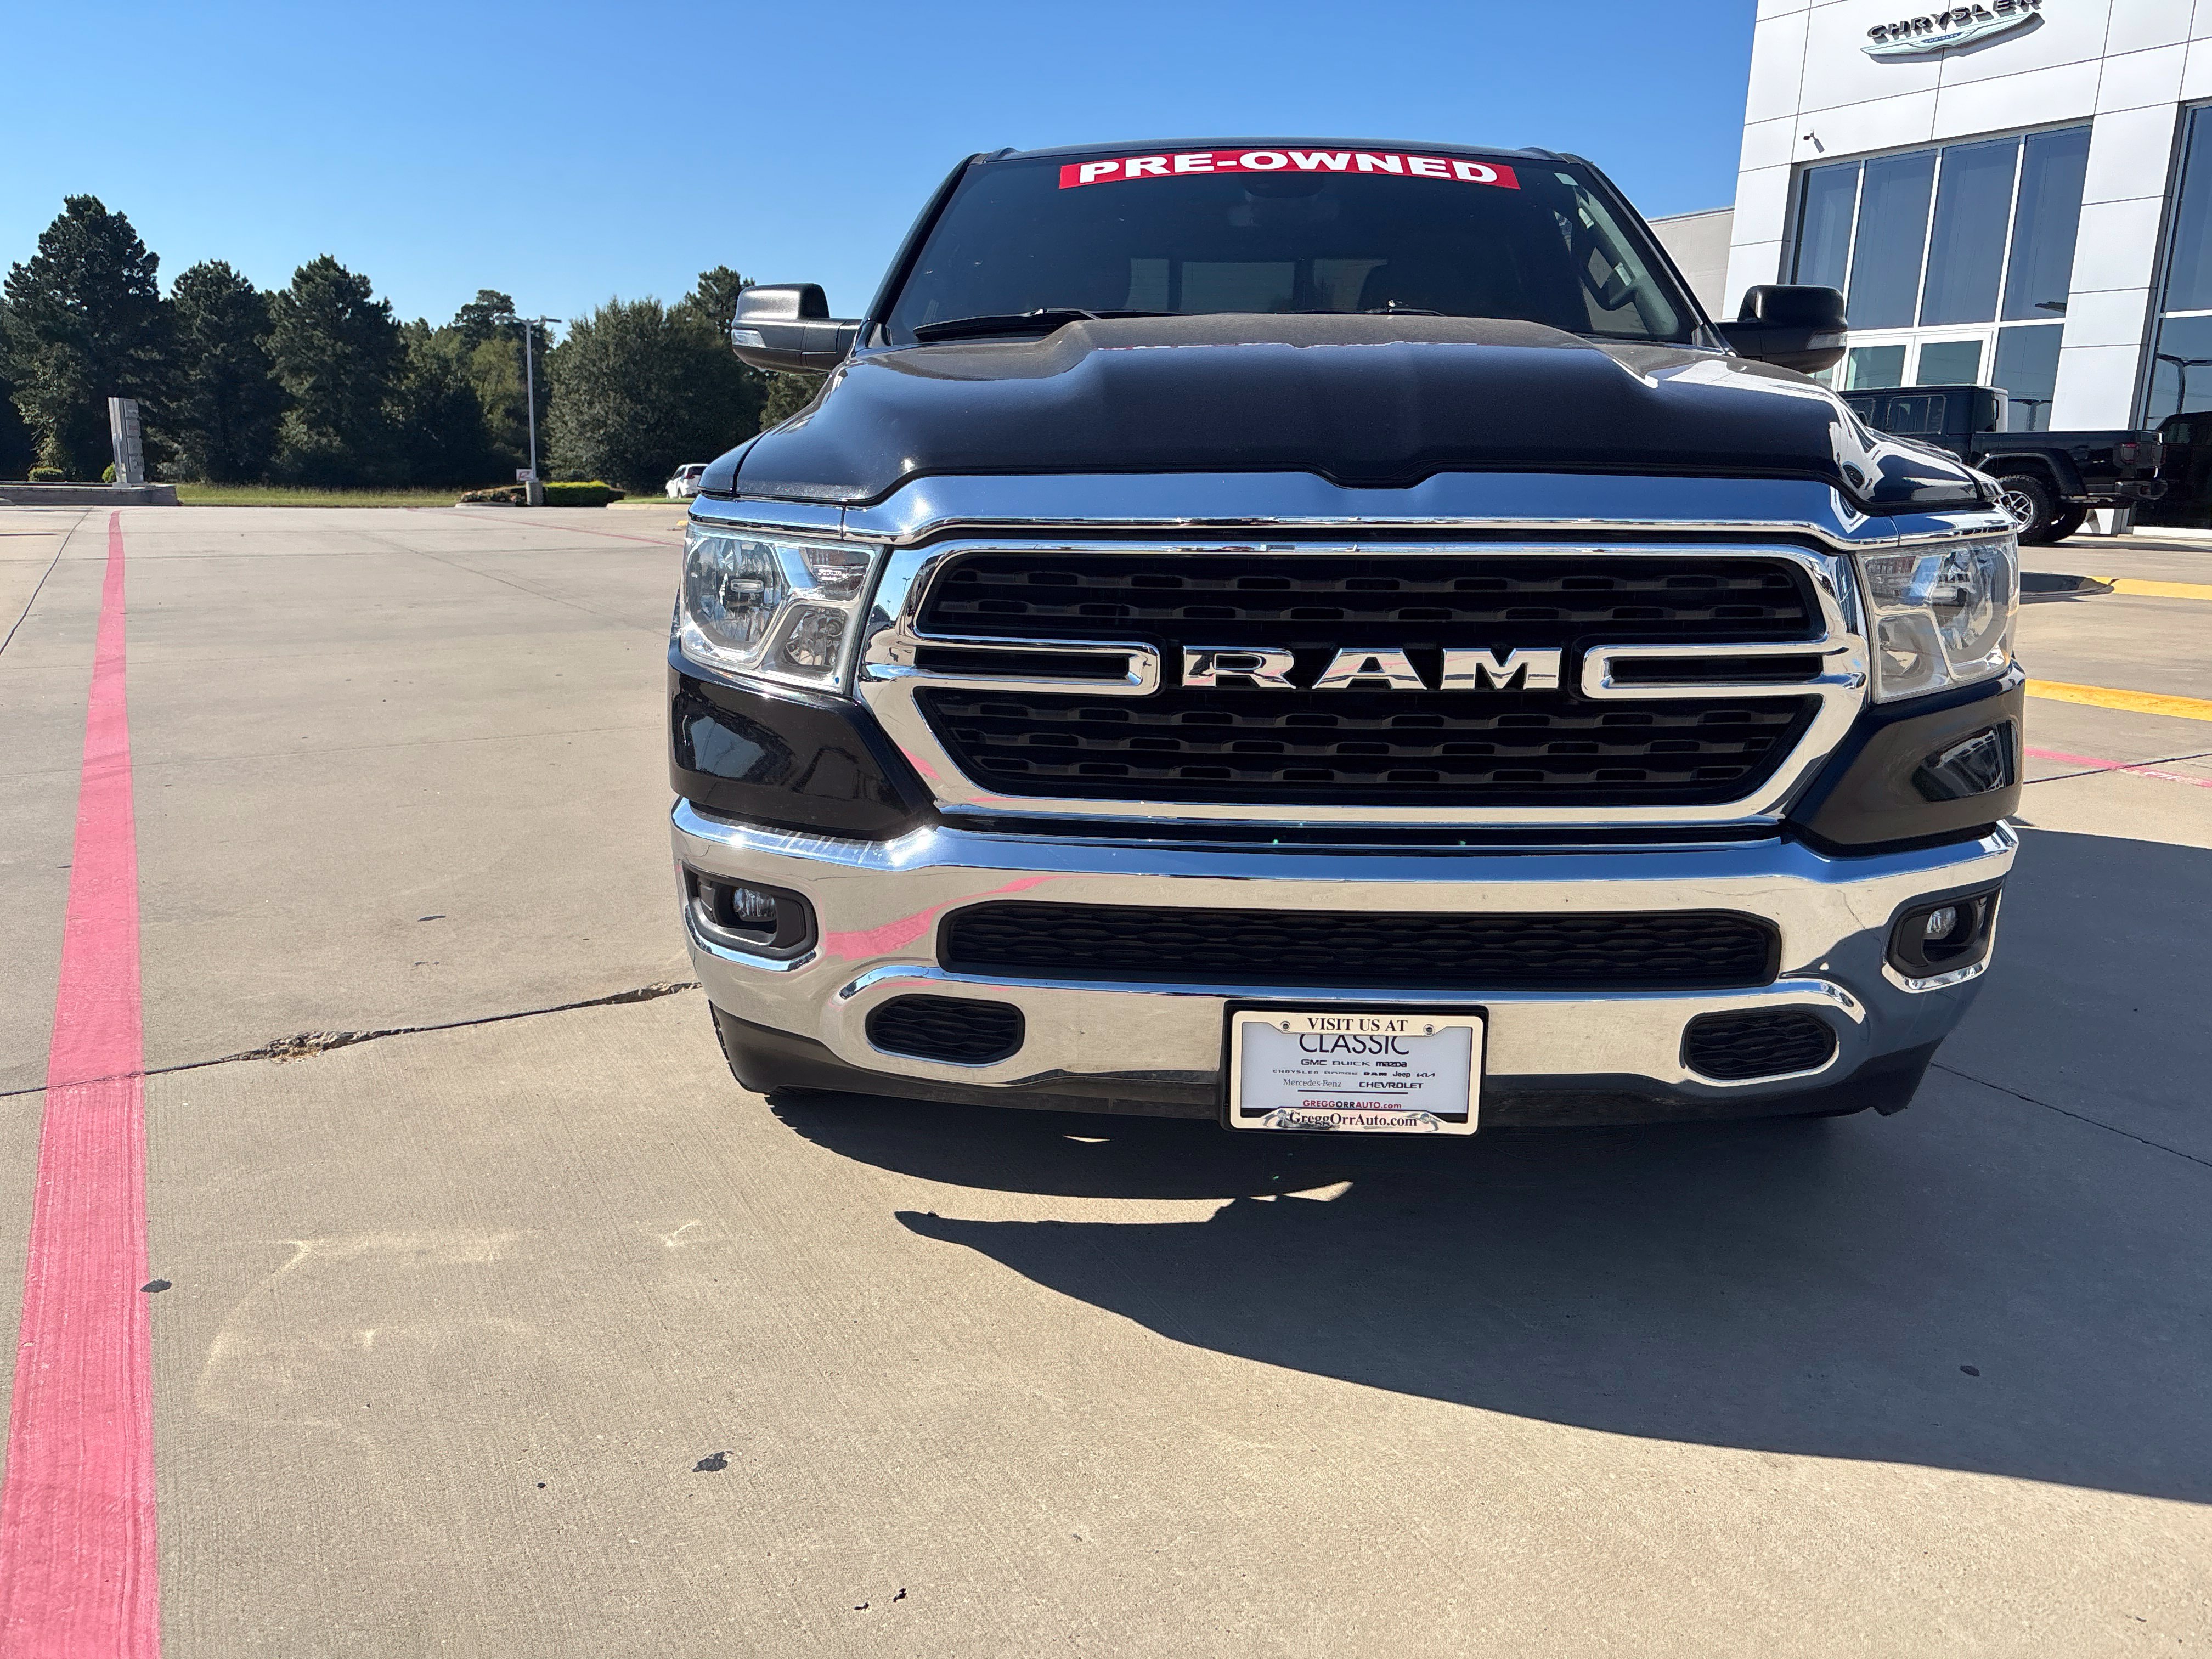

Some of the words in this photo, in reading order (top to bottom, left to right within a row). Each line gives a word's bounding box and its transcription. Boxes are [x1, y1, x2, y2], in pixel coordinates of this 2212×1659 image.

[1078, 151, 1499, 184] PRE-OWNED
[1182, 646, 1562, 690] RAM
[1307, 1018, 1354, 1031] VISIT
[1359, 1019, 1380, 1031] US
[1385, 1019, 1408, 1032] AT
[1299, 1034, 1409, 1055] CLASSIC
[1283, 1078, 1342, 1087] Mercedes-Benz
[1303, 1099, 1402, 1109] GREGGORRAUTO.com
[1289, 1111, 1417, 1127] GreggOrrAuto.com
